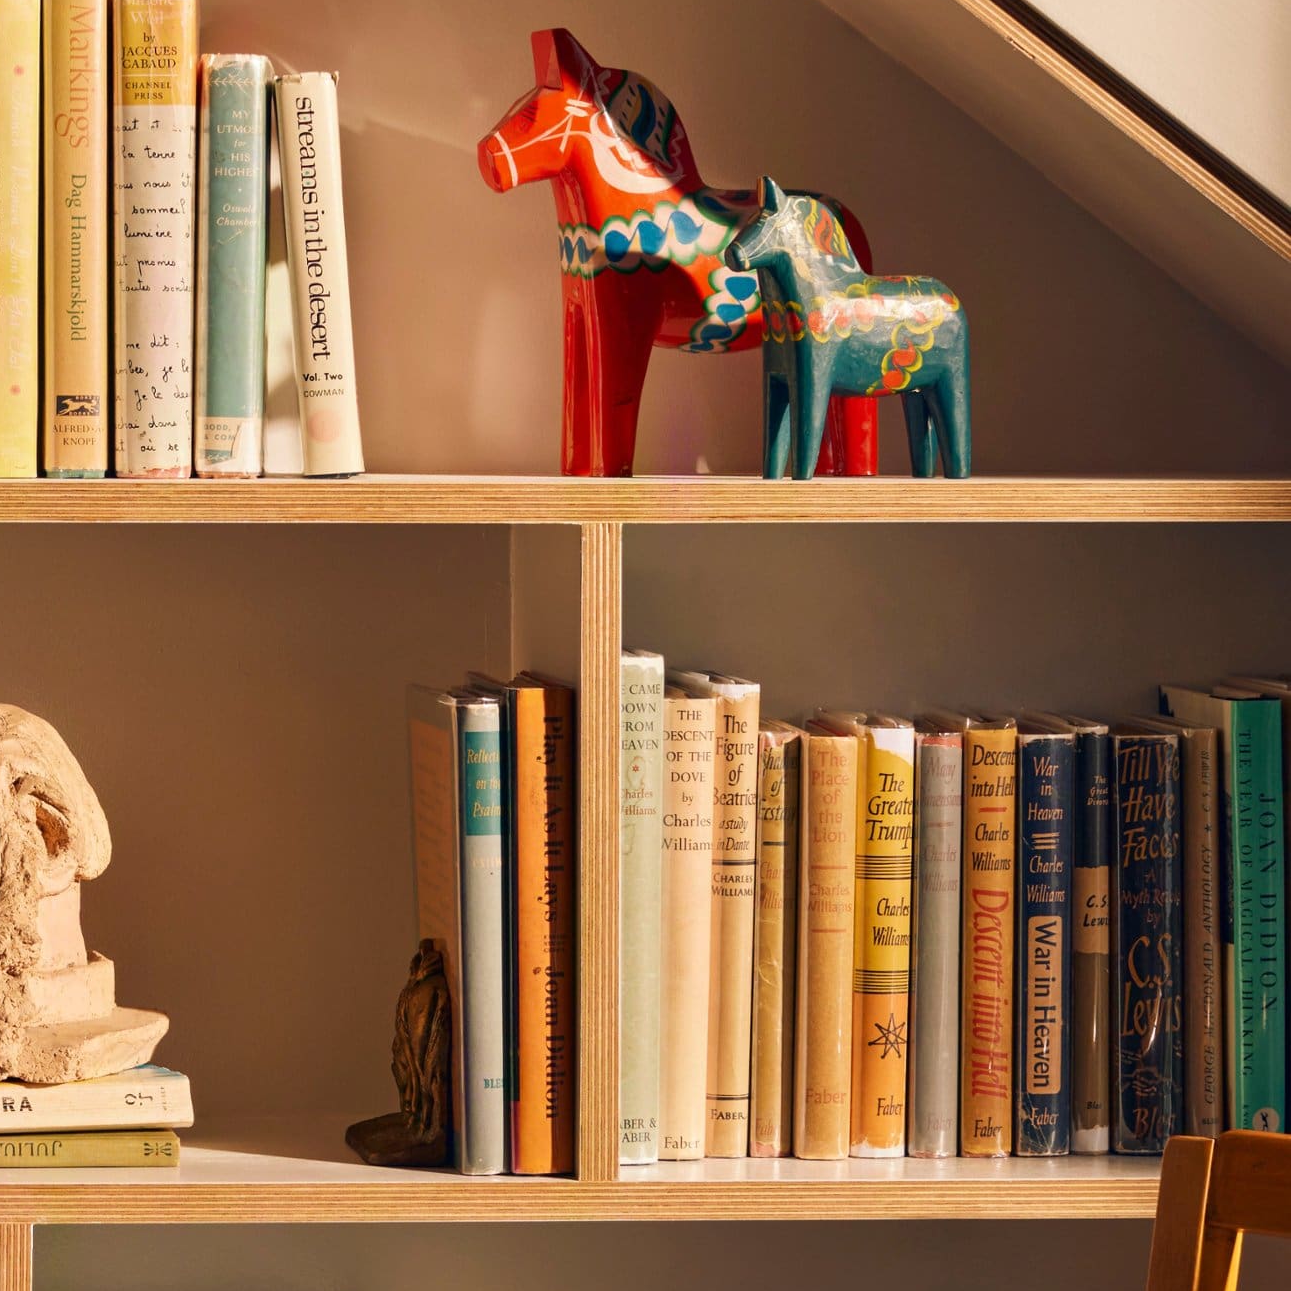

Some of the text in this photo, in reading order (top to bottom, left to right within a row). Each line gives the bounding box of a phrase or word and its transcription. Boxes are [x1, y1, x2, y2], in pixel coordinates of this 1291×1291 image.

[122, 46, 178, 59] JACQUES
[122, 59, 177, 70] CABAUD
[55, 4, 99, 149] Markings
[296, 96, 332, 361] streams in the desert
[302, 373, 343, 381] Vol. Two
[629, 684, 661, 696] CAME
[677, 710, 702, 721] THE
[723, 715, 748, 734] The
[663, 730, 714, 742] DESCENT
[666, 751, 712, 762] OF THE
[715, 737, 755, 762] Figure
[972, 744, 1016, 767] Descent
[671, 772, 706, 782] DOVE
[728, 763, 744, 786] of
[1033, 757, 1059, 778] War
[879, 773, 905, 793] The
[971, 775, 1015, 798] into Hell
[1040, 780, 1053, 797] in
[681, 792, 694, 806] by
[713, 788, 757, 806] Beatrice
[1122, 786, 1177, 823] Have
[663, 814, 711, 827] Charles
[1028, 803, 1063, 821] Heaven
[975, 823, 1010, 842] Charles
[1123, 827, 1180, 868] Faces
[972, 852, 1011, 872] Williams
[1029, 856, 1063, 873] Charles
[1027, 885, 1066, 903] Williams
[1259, 793, 1278, 1009] JOAN DIDION
[877, 897, 911, 917] Charles
[1033, 920, 1057, 1088] War in Heaven
[806, 1089, 847, 1105] Faber
[711, 1109, 747, 1120] FABER
[877, 1097, 903, 1117] Faber
[1029, 1107, 1059, 1126] Faber
[973, 1118, 1002, 1138] Faber
[664, 1136, 700, 1149] Faber
